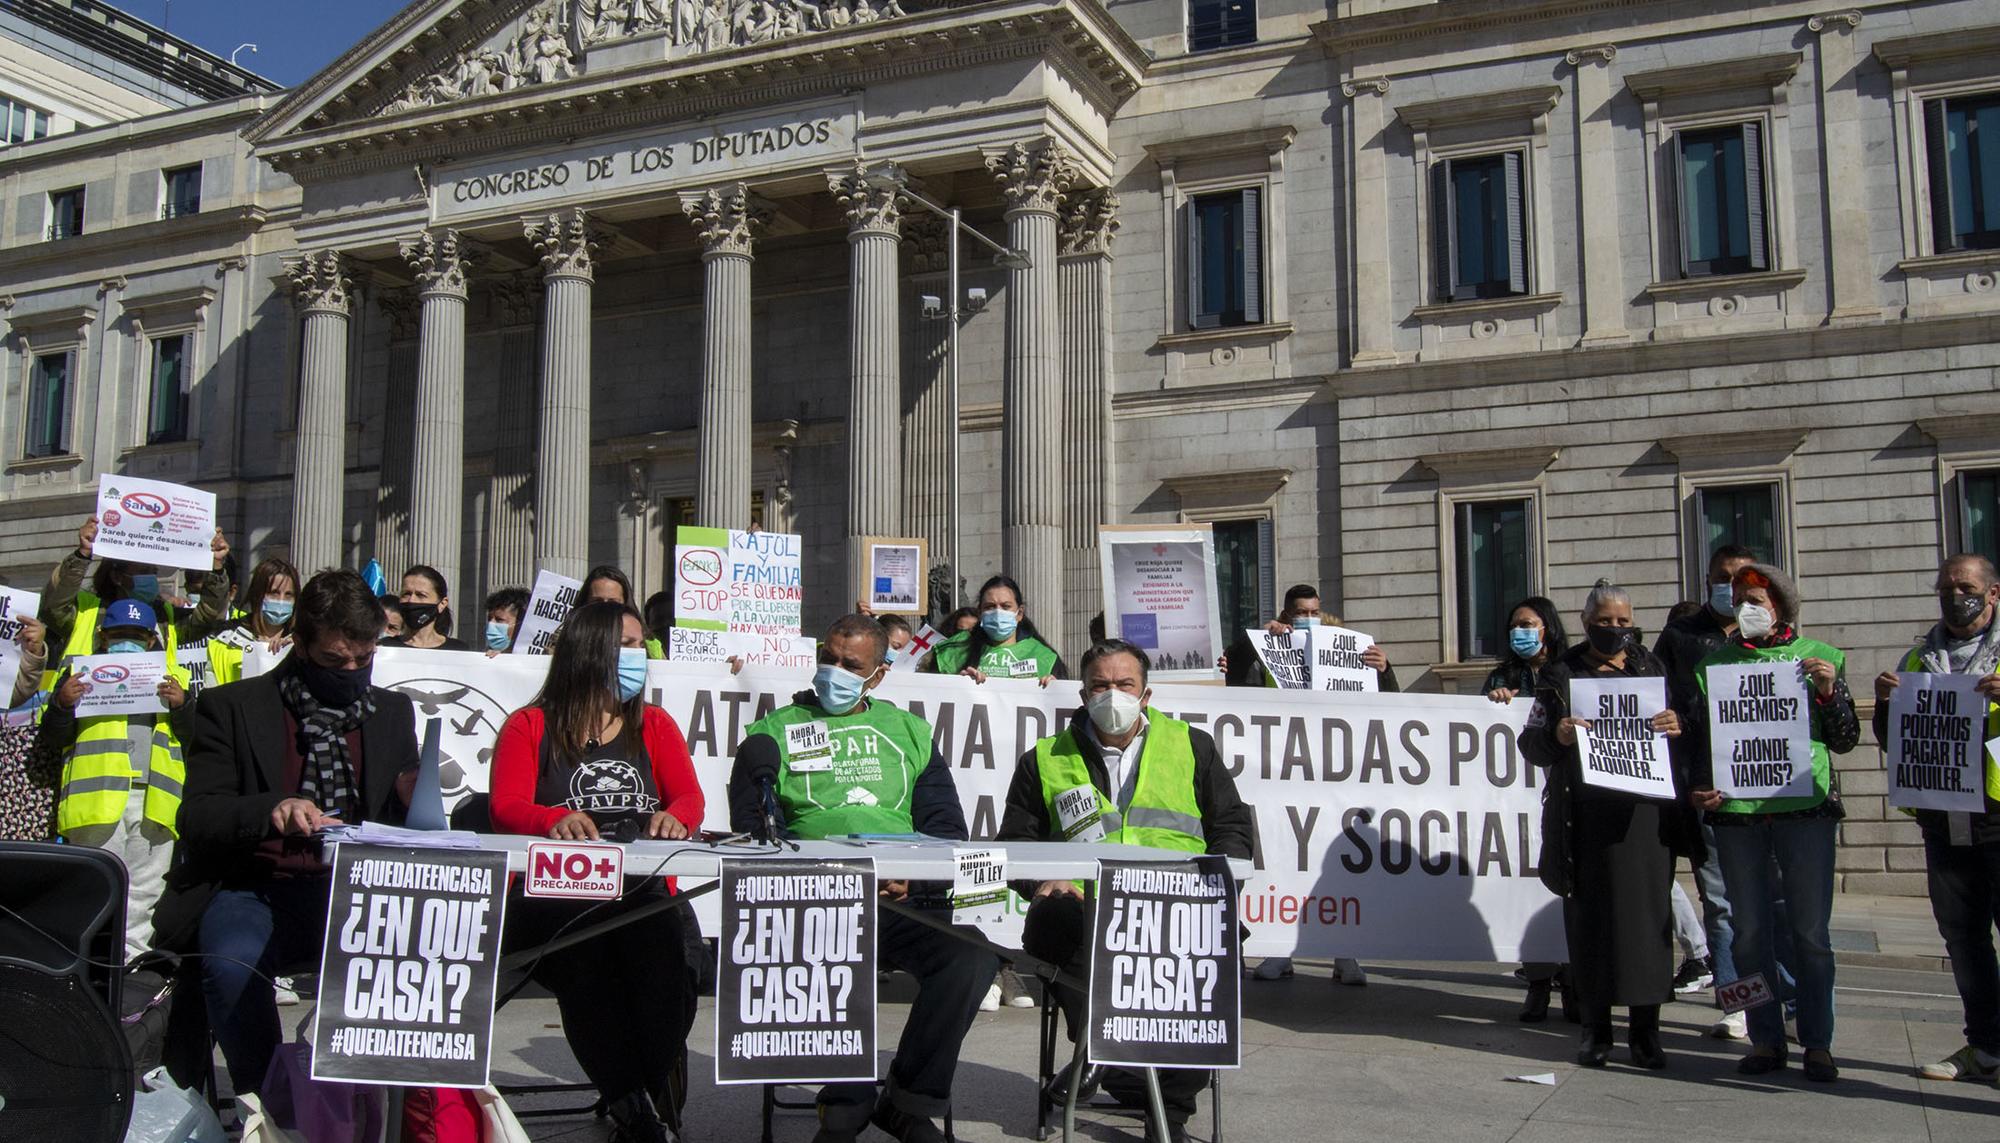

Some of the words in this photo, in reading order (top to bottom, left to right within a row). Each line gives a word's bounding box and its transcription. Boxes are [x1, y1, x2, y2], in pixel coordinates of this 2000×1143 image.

[453, 162, 570, 204] CONGRESO
[586, 155, 614, 182] DE
[630, 147, 674, 175] LOS
[692, 119, 830, 165] DIPUTADOS
[124, 498, 161, 514] Sareb
[100, 537, 123, 545] miles
[137, 542, 170, 552] familias
[102, 527, 126, 537] Sareb
[128, 531, 154, 541] quiere
[156, 535, 196, 547] desauciar
[732, 533, 798, 557] KAJOL
[758, 554, 769, 567] Y
[733, 563, 801, 587] FAMILIA
[681, 590, 728, 611] STOP
[731, 583, 749, 598] SE
[128, 604, 141, 620] LA
[731, 599, 752, 611] POR
[732, 611, 740, 622] A
[744, 612, 757, 623] LA
[690, 632, 718, 647] JOSE
[764, 637, 791, 654] NO
[1278, 633, 1292, 650] NO
[1261, 647, 1305, 667] PODEMOS
[94, 671, 123, 680] Sareb
[1293, 665, 1311, 682] LOS
[1738, 672, 1776, 700] ¿QUÉ
[1599, 694, 1614, 718] SI
[1618, 694, 1638, 718] NO
[1718, 697, 1798, 724] HACEMOS?
[1917, 689, 1932, 715] SI
[1936, 690, 1957, 716] NO
[790, 725, 816, 741] AHORA
[802, 738, 812, 748] LA
[814, 732, 826, 746] LEY
[1584, 718, 1655, 741] PODEMOS
[1900, 714, 1971, 742] PODEMOS
[831, 734, 878, 758] PAH
[1589, 737, 1637, 761] PAGAR
[1642, 741, 1656, 761] EL
[1732, 737, 1790, 763] ¿DÓNDE
[1901, 739, 1950, 767] PAGAR
[1954, 742, 1969, 767] EL
[832, 757, 880, 768] PLATAFORMA
[834, 767, 844, 776] DE
[1588, 753, 1665, 782] ALQUILER...
[1731, 763, 1793, 788] VAMOS?
[1896, 763, 1975, 793] ALQUILER...
[575, 795, 644, 810] PAVPS
[1060, 790, 1082, 811] AHORA
[1070, 804, 1081, 817] LA
[1080, 796, 1093, 811] LEY
[1285, 806, 1321, 873] Y
[1340, 806, 1541, 879] SOCIAL
[534, 852, 616, 880] NO+
[960, 852, 992, 871] AHORA
[350, 859, 492, 895] #QUEDATEENCASA
[533, 879, 615, 891] PRECARIEDAD
[974, 868, 985, 885] LA
[988, 864, 1003, 882] LEY
[1112, 868, 1227, 897] #QUEDATEENCASA
[735, 874, 865, 904] #QUEDATEENCASA
[340, 893, 415, 957] ¿EN
[418, 898, 490, 966] QUÉ
[732, 908, 796, 965] ¿EN
[802, 902, 864, 966] QUÉ
[1105, 898, 1163, 955] ¿EN
[1169, 899, 1227, 960] QUÉ
[344, 957, 472, 1024] CASA?
[740, 964, 853, 1024] CASA?
[1111, 955, 1218, 1013] CASA?
[1103, 1016, 1228, 1044] #QUEDATEENCASA
[331, 1026, 476, 1061] #QUEDATEENCASA
[731, 1029, 864, 1060] #QUEDATEENCASA
